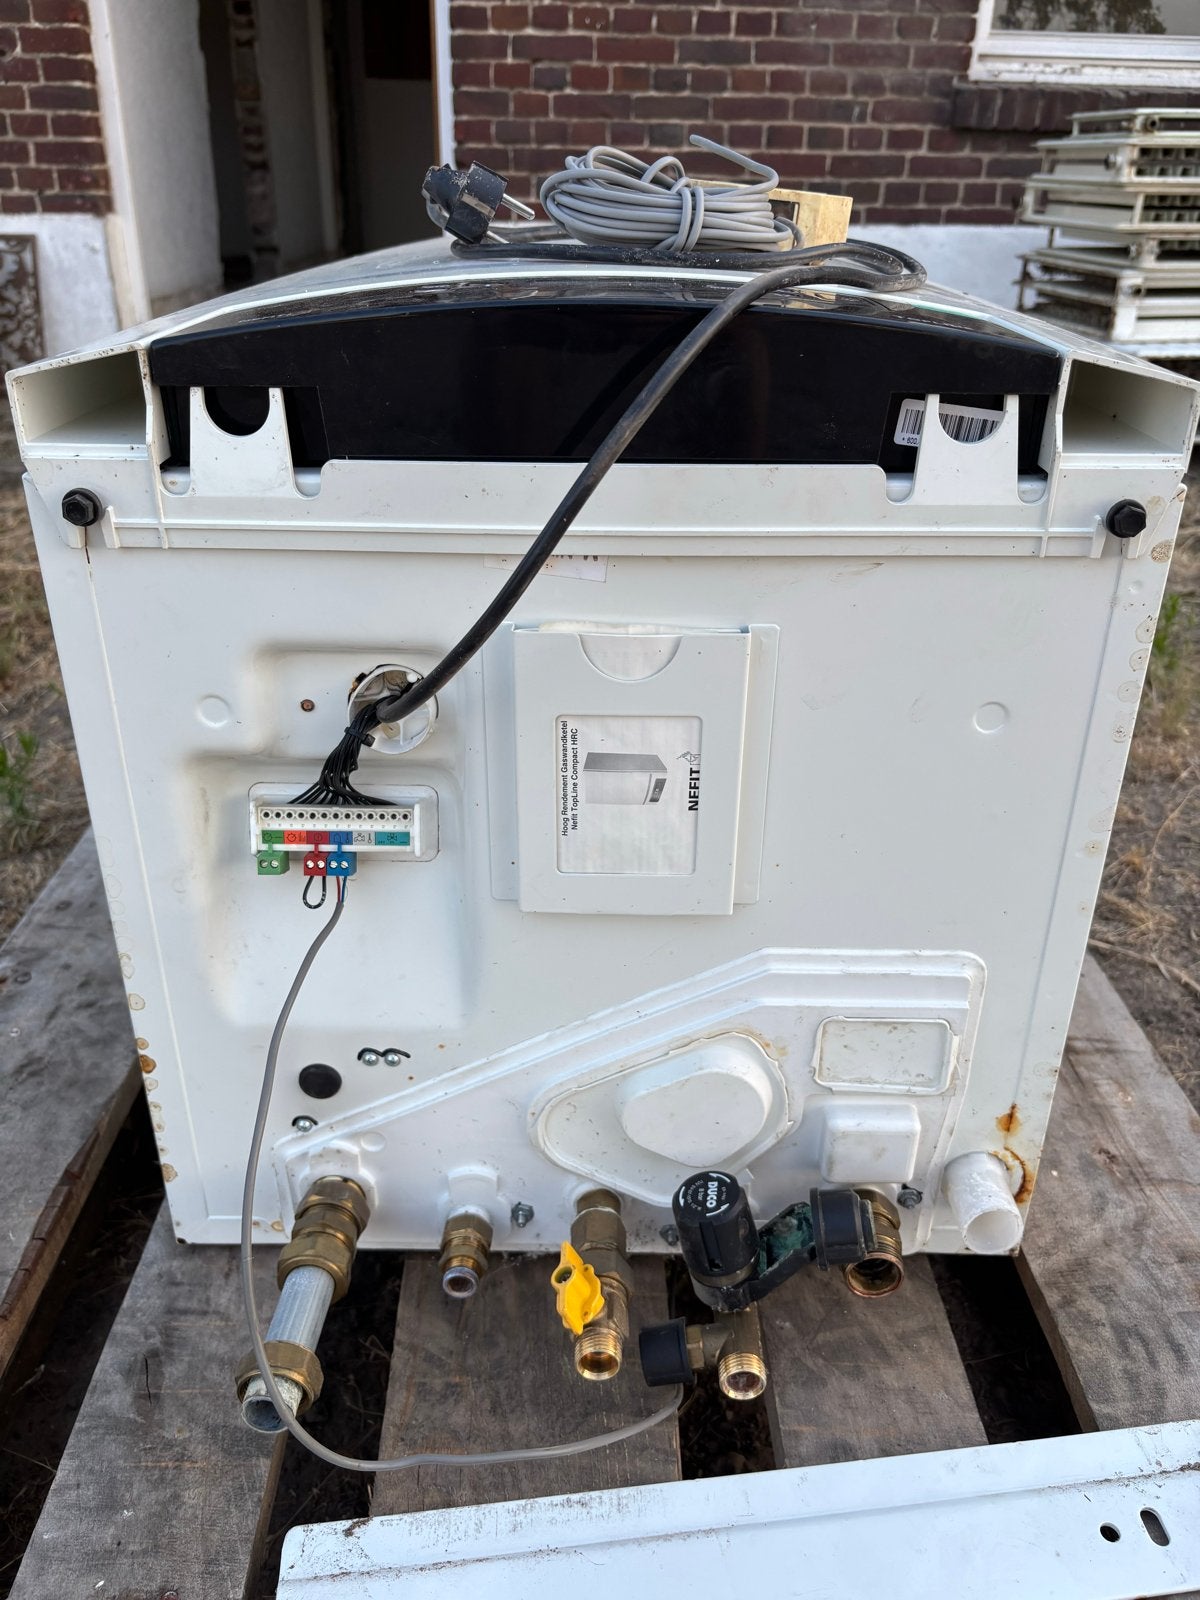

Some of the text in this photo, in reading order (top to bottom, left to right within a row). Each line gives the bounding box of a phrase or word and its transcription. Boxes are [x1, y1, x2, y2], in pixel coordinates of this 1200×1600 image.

[560, 720, 568, 773] Gaswandketel
[570, 728, 578, 745] HRC
[571, 747, 579, 781] Compact
[571, 782, 579, 811] TopLine
[688, 767, 700, 811] NEFIT
[561, 817, 569, 836] Hoog
[706, 1181, 718, 1208] DUCO
